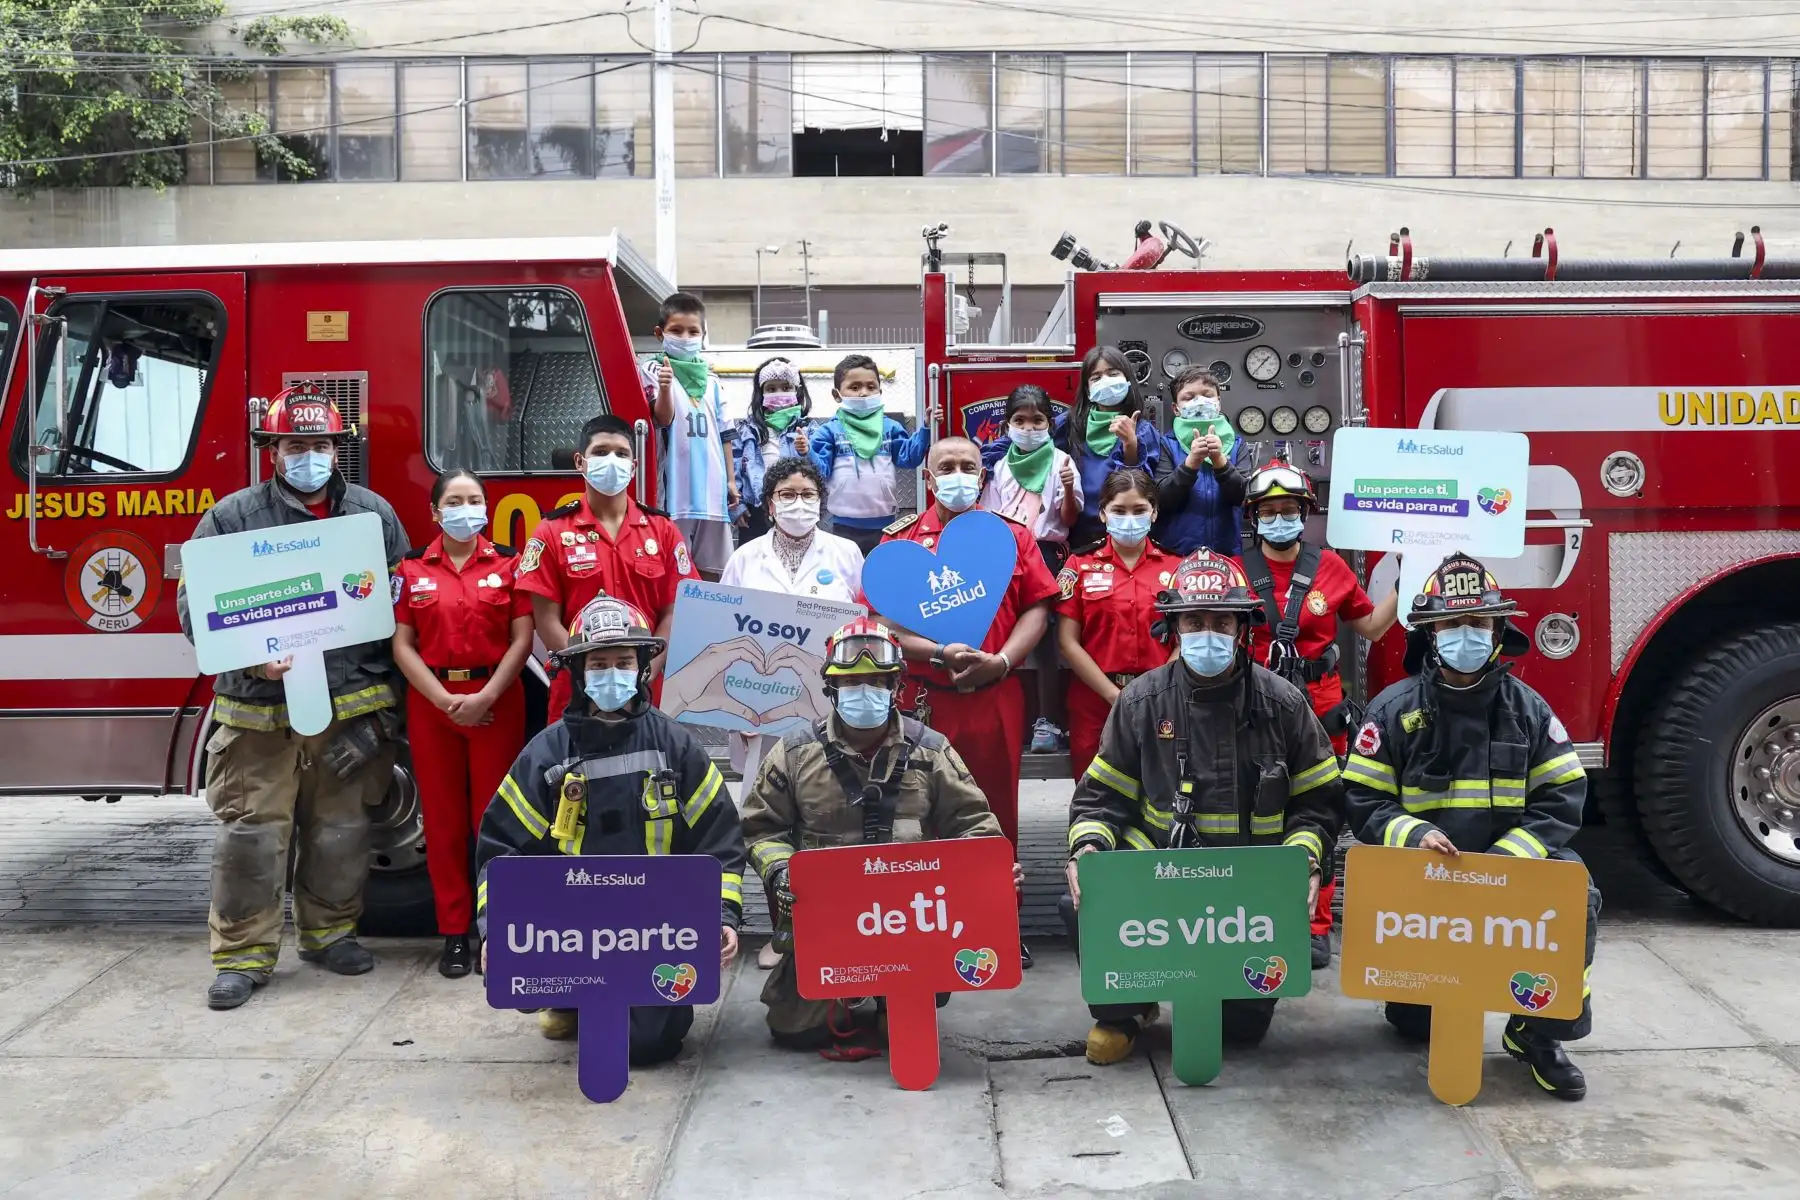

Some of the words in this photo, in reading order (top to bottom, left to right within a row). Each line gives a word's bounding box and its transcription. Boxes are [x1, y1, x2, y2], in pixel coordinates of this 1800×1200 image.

[1065, 375, 1073, 390] 1
[293, 407, 325, 422] 202
[991, 408, 1007, 417] JES
[1658, 391, 1800, 425] UNIDAD
[686, 412, 709, 438] 10
[1420, 445, 1463, 456] EsSalud
[1357, 484, 1381, 495] Una
[1383, 485, 1417, 498] parte
[1418, 485, 1434, 495] de
[1436, 483, 1449, 496] ti,
[6, 492, 106, 518] JESUS
[117, 488, 217, 516] MARIA
[1357, 500, 1373, 508] es
[1374, 499, 1404, 510] vida
[1405, 502, 1438, 514] para
[276, 536, 321, 553] EsSalud
[1571, 533, 1579, 549] 2
[1181, 561, 1202, 573] JESUS
[1203, 561, 1227, 571] MARIA
[1185, 574, 1222, 591] 202
[1444, 572, 1481, 596] 202
[219, 596, 246, 610] Una
[247, 590, 282, 606] parte
[284, 585, 299, 596] de
[300, 579, 314, 592] ti,
[704, 591, 743, 606] EsSalud
[919, 579, 987, 619] EsSalud
[1451, 598, 1477, 606] PINTO
[223, 614, 240, 625] es
[242, 606, 273, 621] vida
[274, 601, 307, 617] para
[796, 608, 837, 621] Rebagliati
[797, 600, 812, 610] Red
[813, 603, 862, 617] Prestacional
[98, 618, 130, 629] PERU
[590, 611, 622, 630] 202
[734, 612, 763, 634] Yo
[767, 622, 811, 646] soy
[725, 675, 803, 697] Rebagliati
[890, 858, 940, 873] EsSalud
[1182, 865, 1233, 879] EsSalud
[594, 873, 646, 886] EsSalud
[1452, 870, 1507, 886] EsSalud
[857, 902, 907, 936] de
[910, 885, 964, 939] ti,
[1119, 918, 1170, 948] es
[1177, 905, 1274, 945] vida
[1375, 910, 1473, 944] para
[1484, 909, 1559, 952] mí.
[507, 923, 583, 954] Una
[592, 922, 699, 960] parte
[847, 964, 911, 975] PRESTACIONAL
[1133, 970, 1197, 980] PRESTACIONAL
[1394, 970, 1462, 985] PRESTACIONAL
[540, 976, 607, 985] PRESTACIONAL
